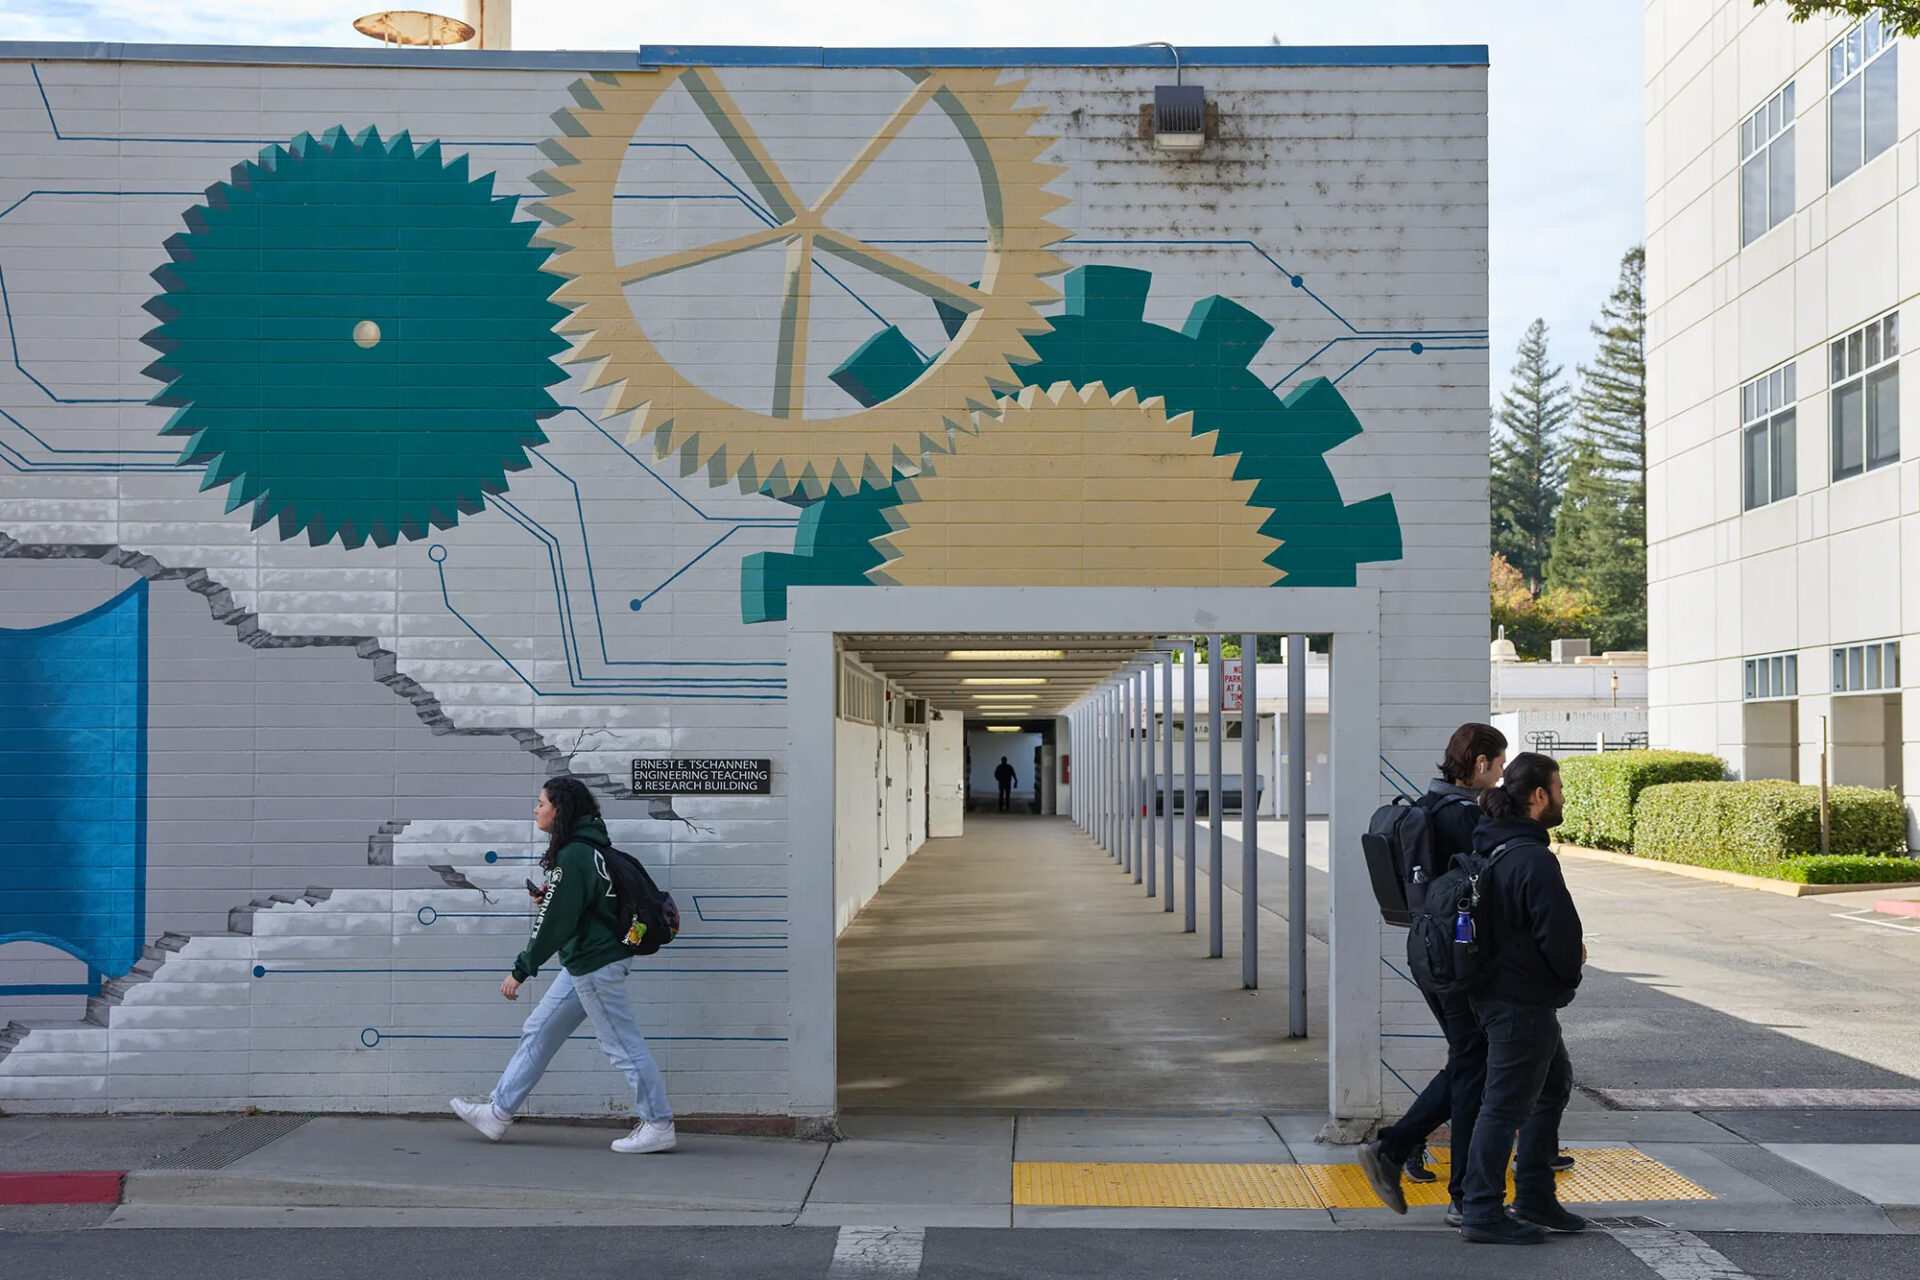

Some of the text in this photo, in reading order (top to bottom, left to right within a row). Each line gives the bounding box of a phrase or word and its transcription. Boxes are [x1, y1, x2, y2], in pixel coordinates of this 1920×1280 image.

[634, 760, 758, 769] ERNEST E. TSCHANNEN
[634, 771, 767, 780] ENGINEERING TEACHING
[634, 781, 758, 790] & RESEARCH BUILDING
[531, 883, 557, 939] HORNETS
